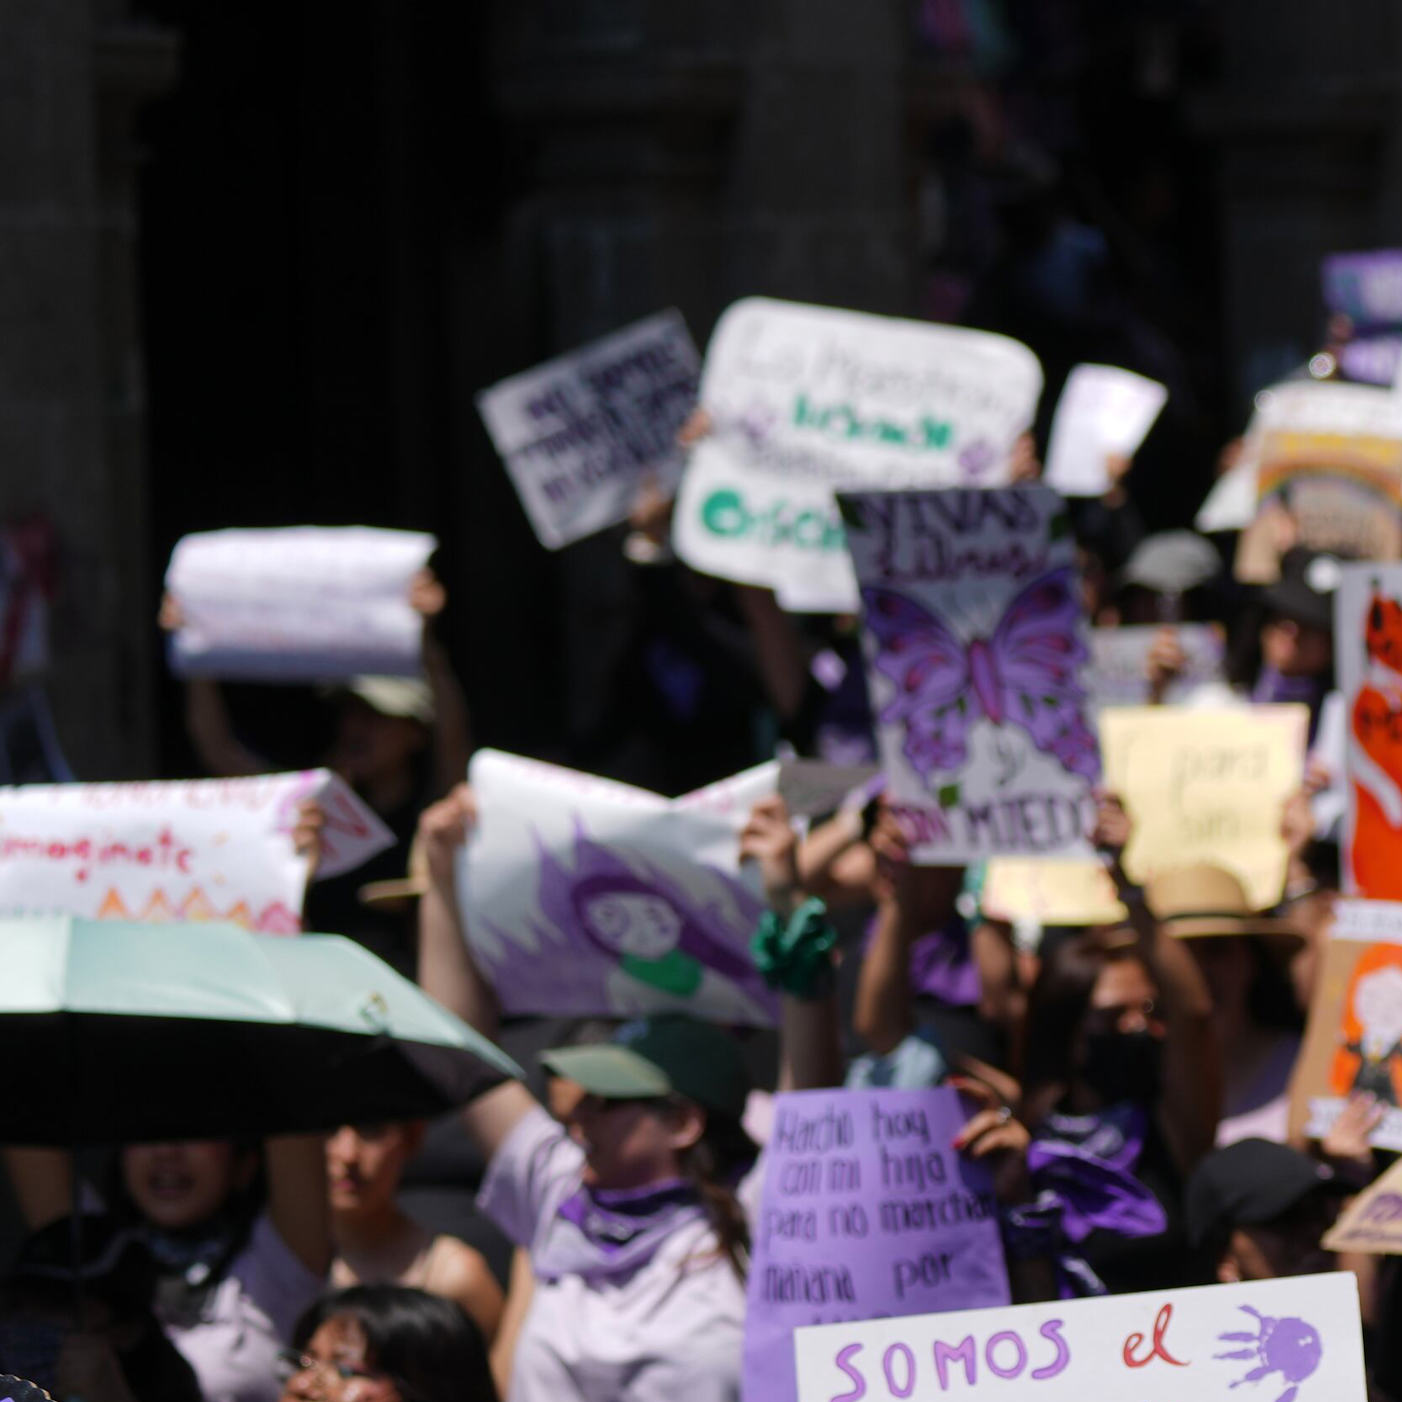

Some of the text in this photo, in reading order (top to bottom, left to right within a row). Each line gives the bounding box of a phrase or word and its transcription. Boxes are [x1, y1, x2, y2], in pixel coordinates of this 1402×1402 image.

[765, 1205, 818, 1244] para
[828, 1205, 869, 1238] no
[892, 1251, 956, 1299] por
[1120, 1301, 1192, 1369] el
